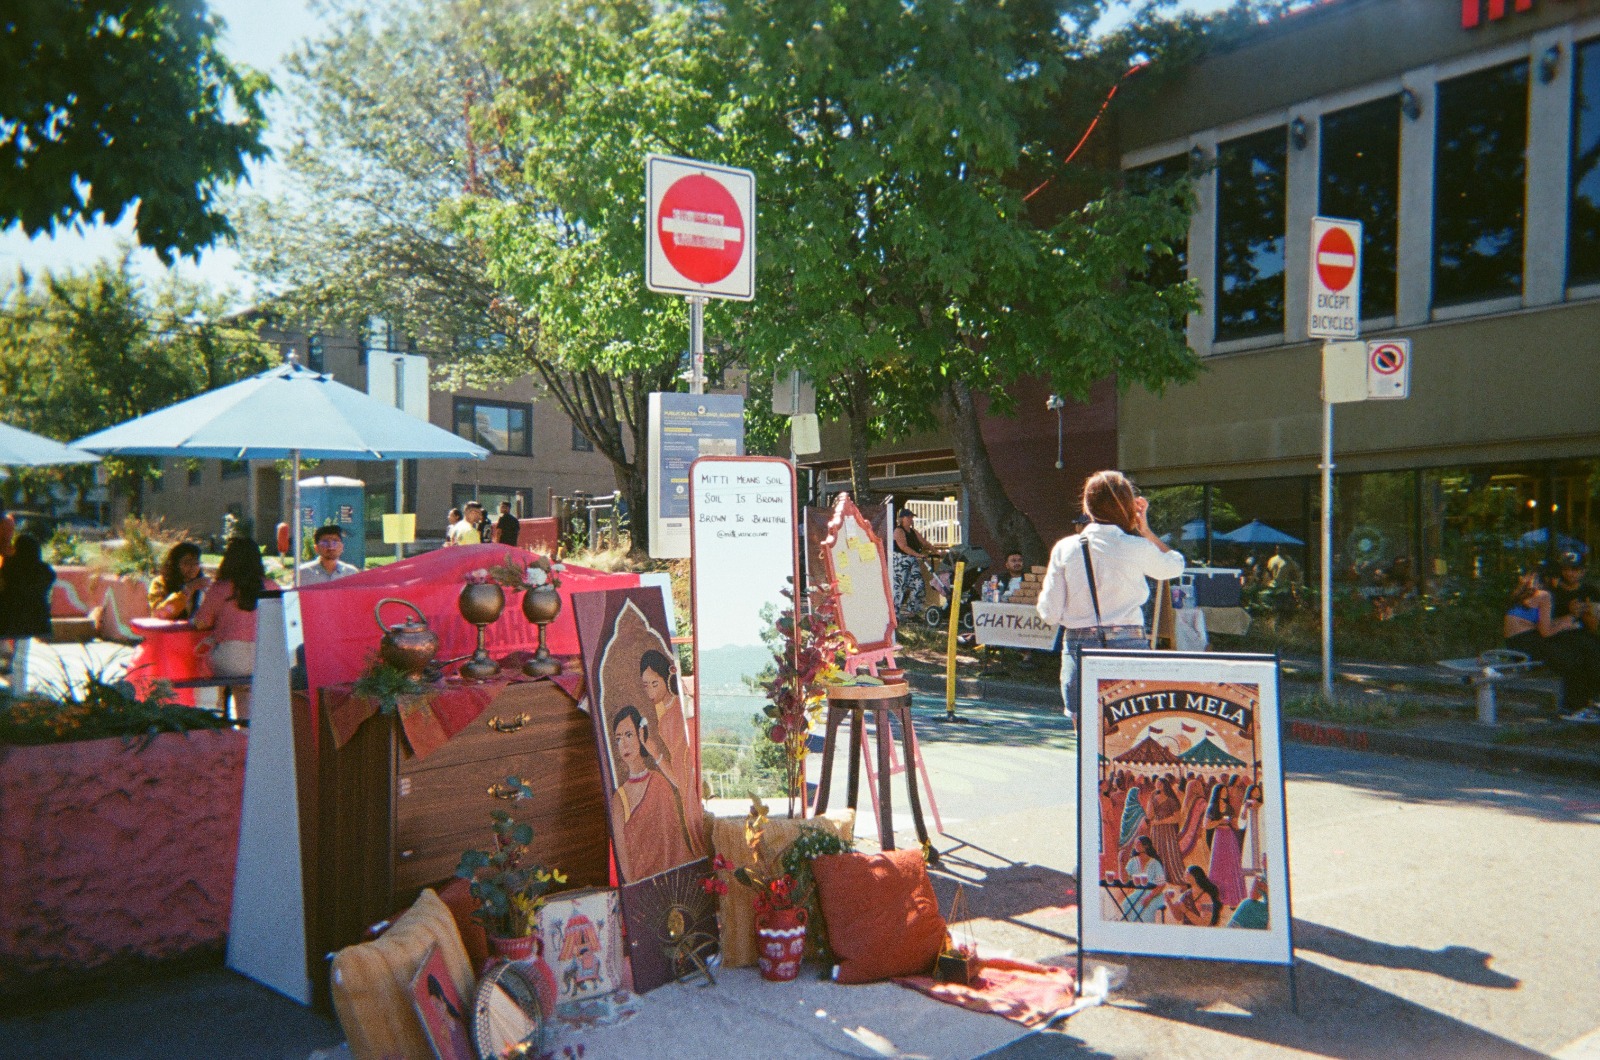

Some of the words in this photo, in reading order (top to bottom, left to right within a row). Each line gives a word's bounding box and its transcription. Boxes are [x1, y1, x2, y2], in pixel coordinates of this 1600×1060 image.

[1318, 294, 1349, 309] EXCEPT
[1312, 315, 1354, 330] BICYCLES
[702, 474, 729, 484] MITTI
[737, 476, 760, 485] MEANS
[766, 476, 784, 484] SOIL
[704, 493, 722, 504] SOIL
[736, 493, 746, 503] IS
[756, 493, 783, 504] BROWN
[699, 513, 727, 523] BROWN
[735, 514, 744, 523] IS
[752, 514, 788, 524] BEAUTIFUL
[1109, 692, 1176, 722] MITTI
[1184, 692, 1246, 726] MELA
